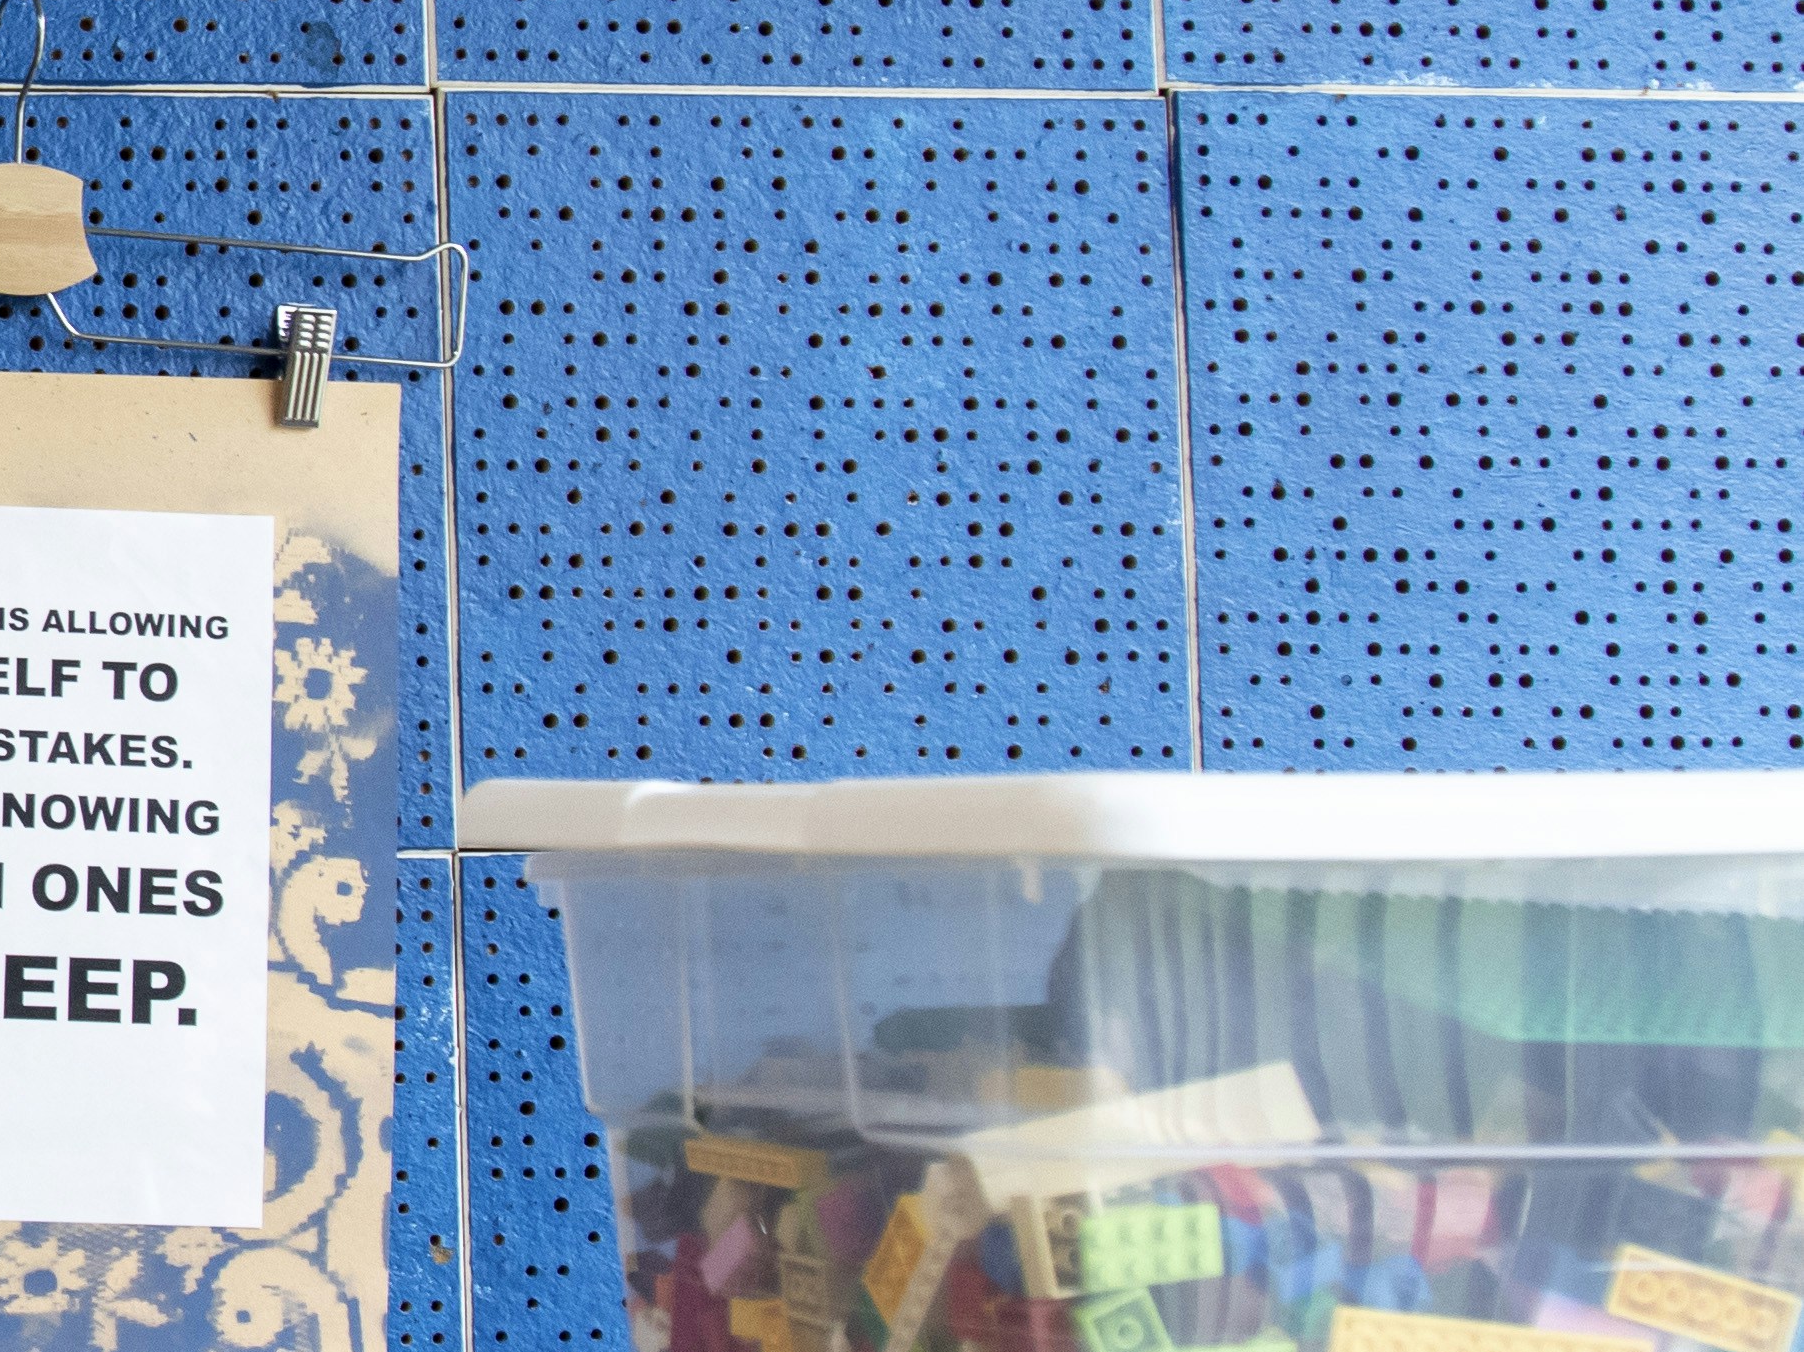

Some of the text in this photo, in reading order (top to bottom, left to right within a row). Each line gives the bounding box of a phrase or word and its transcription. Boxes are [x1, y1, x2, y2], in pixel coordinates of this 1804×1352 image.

[42, 610, 228, 639] ALLOWING
[102, 661, 177, 702] TO
[32, 864, 223, 917] ONES
